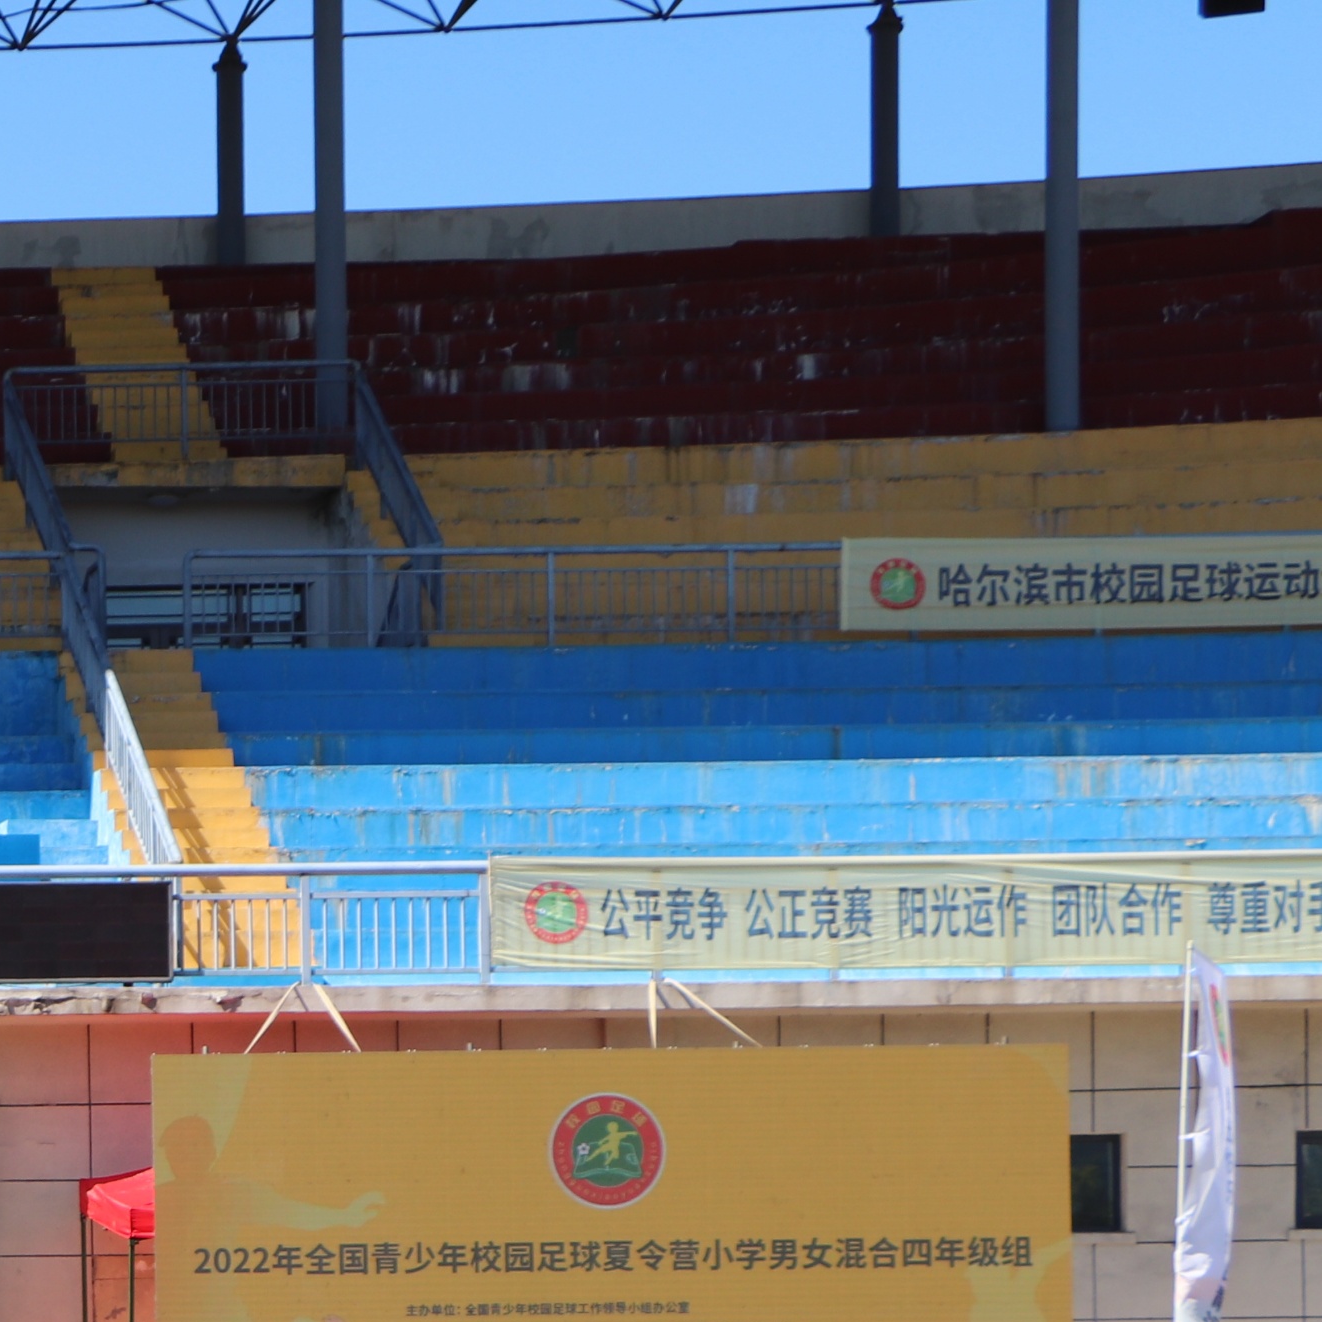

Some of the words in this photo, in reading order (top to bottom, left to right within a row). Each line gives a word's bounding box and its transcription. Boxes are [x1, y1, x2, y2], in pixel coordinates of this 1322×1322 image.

[601, 887, 727, 941] 公平竞争
[746, 886, 873, 939] 公正竞赛
[898, 883, 1027, 938] 阳光运作
[1052, 883, 1182, 936] 团队合作
[193, 1237, 1032, 1275] 2022年全国青少年校园足球夏令营小学男女混合四年级组
